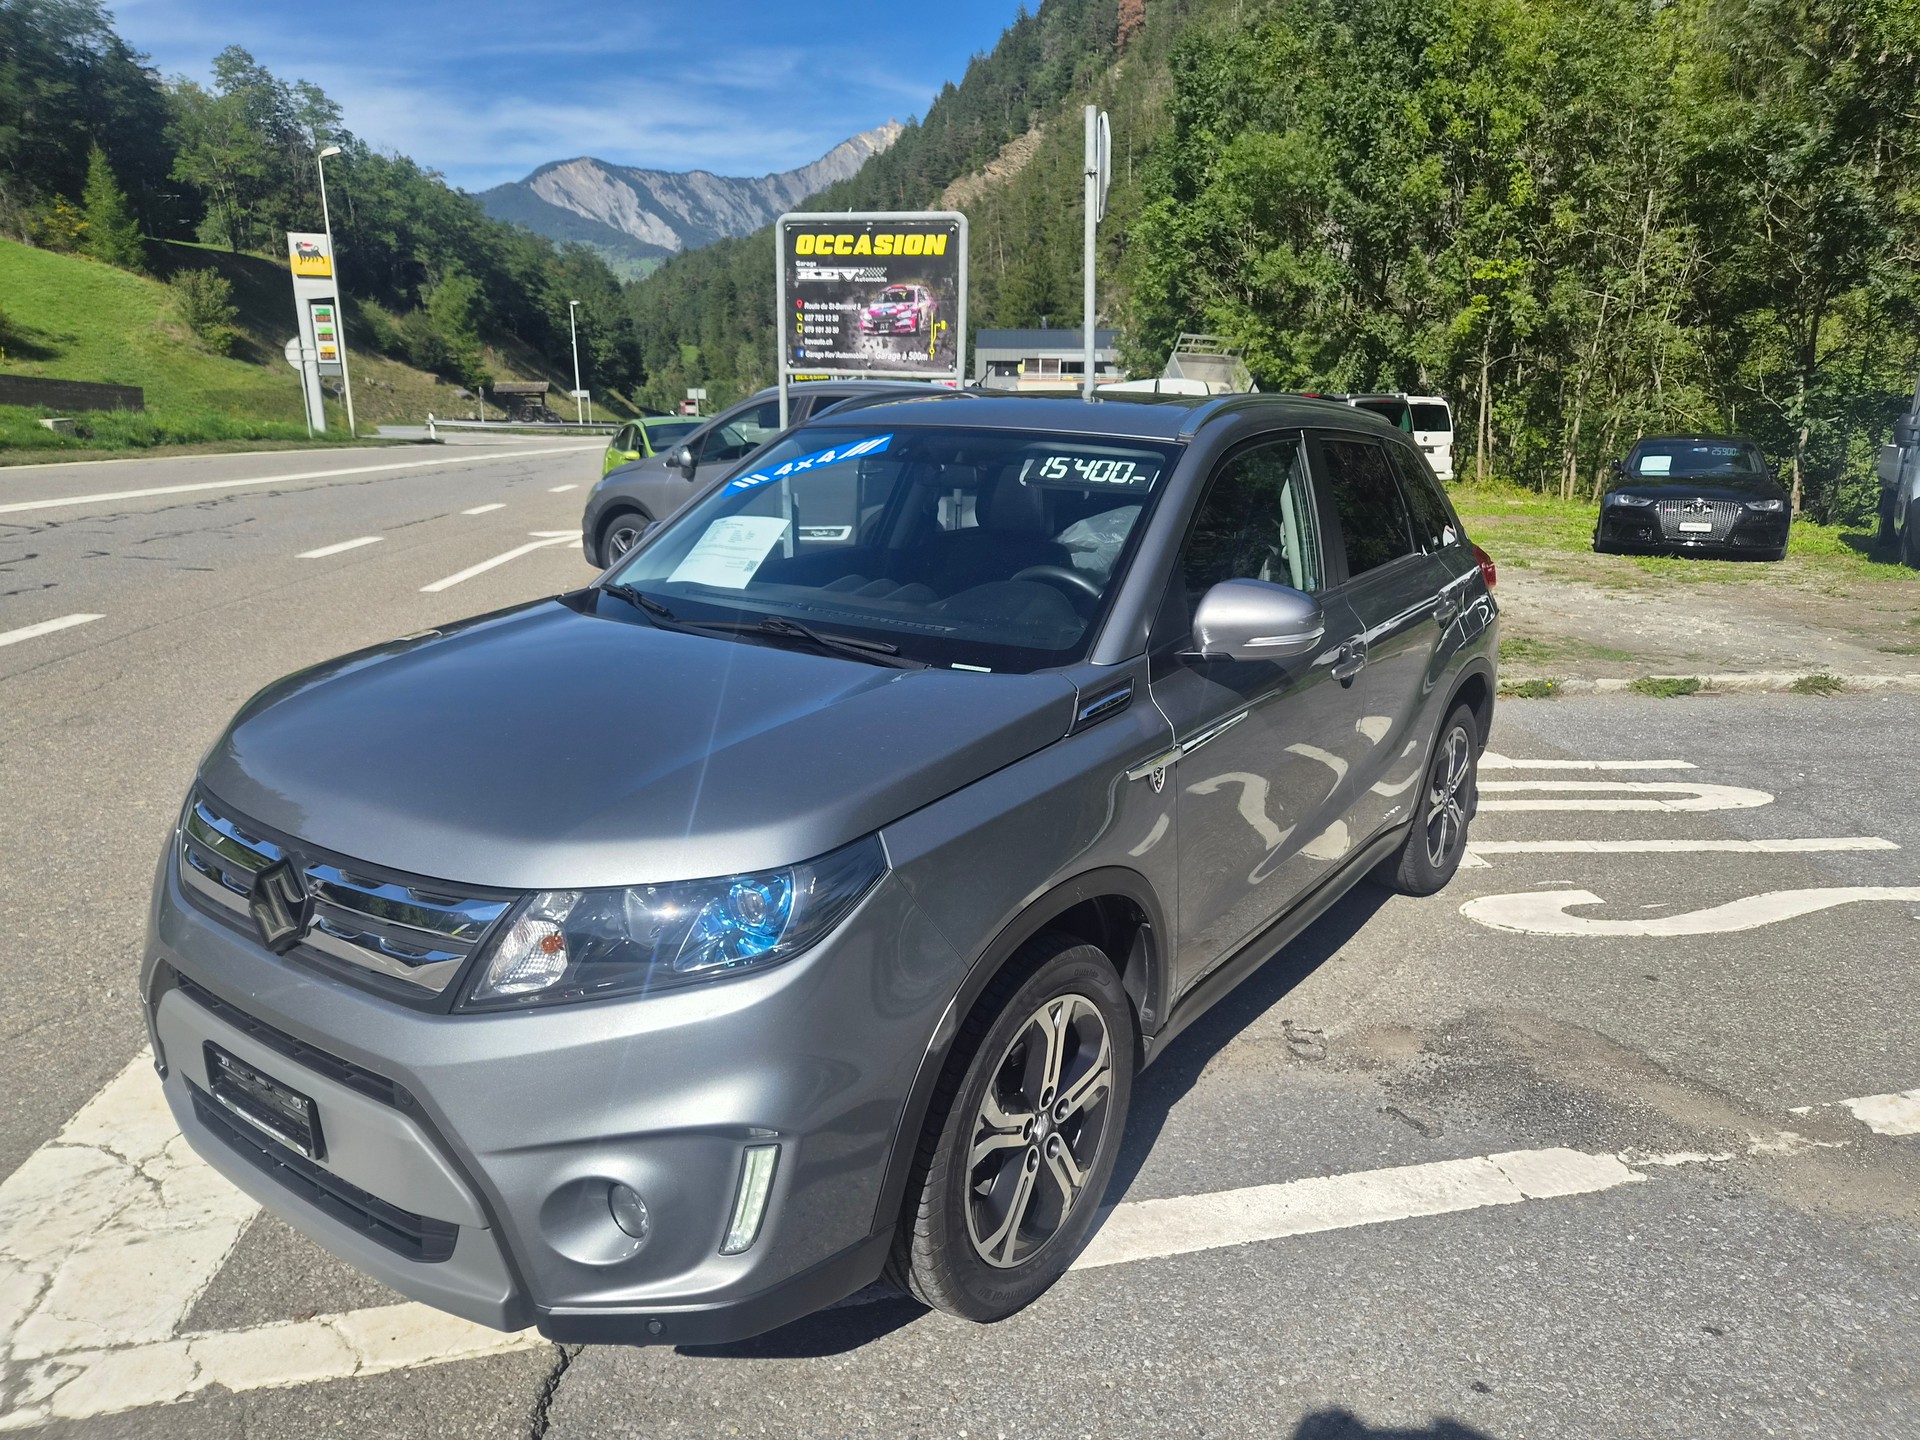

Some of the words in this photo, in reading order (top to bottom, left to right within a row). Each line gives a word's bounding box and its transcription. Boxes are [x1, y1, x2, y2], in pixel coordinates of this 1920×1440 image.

[795, 234, 948, 256] OCCASION
[795, 260, 817, 268] Garage
[804, 302, 820, 310] Route
[829, 302, 857, 311] St-Bernard
[804, 314, 815, 322] 027
[804, 337, 834, 346] kevauto.ch
[805, 351, 825, 360] Garage
[875, 350, 901, 362] Garage
[901, 352, 907, 361] à
[908, 351, 928, 362] 500m
[773, 449, 837, 477] 4x4
[1039, 456, 1146, 485] 15'400.-
